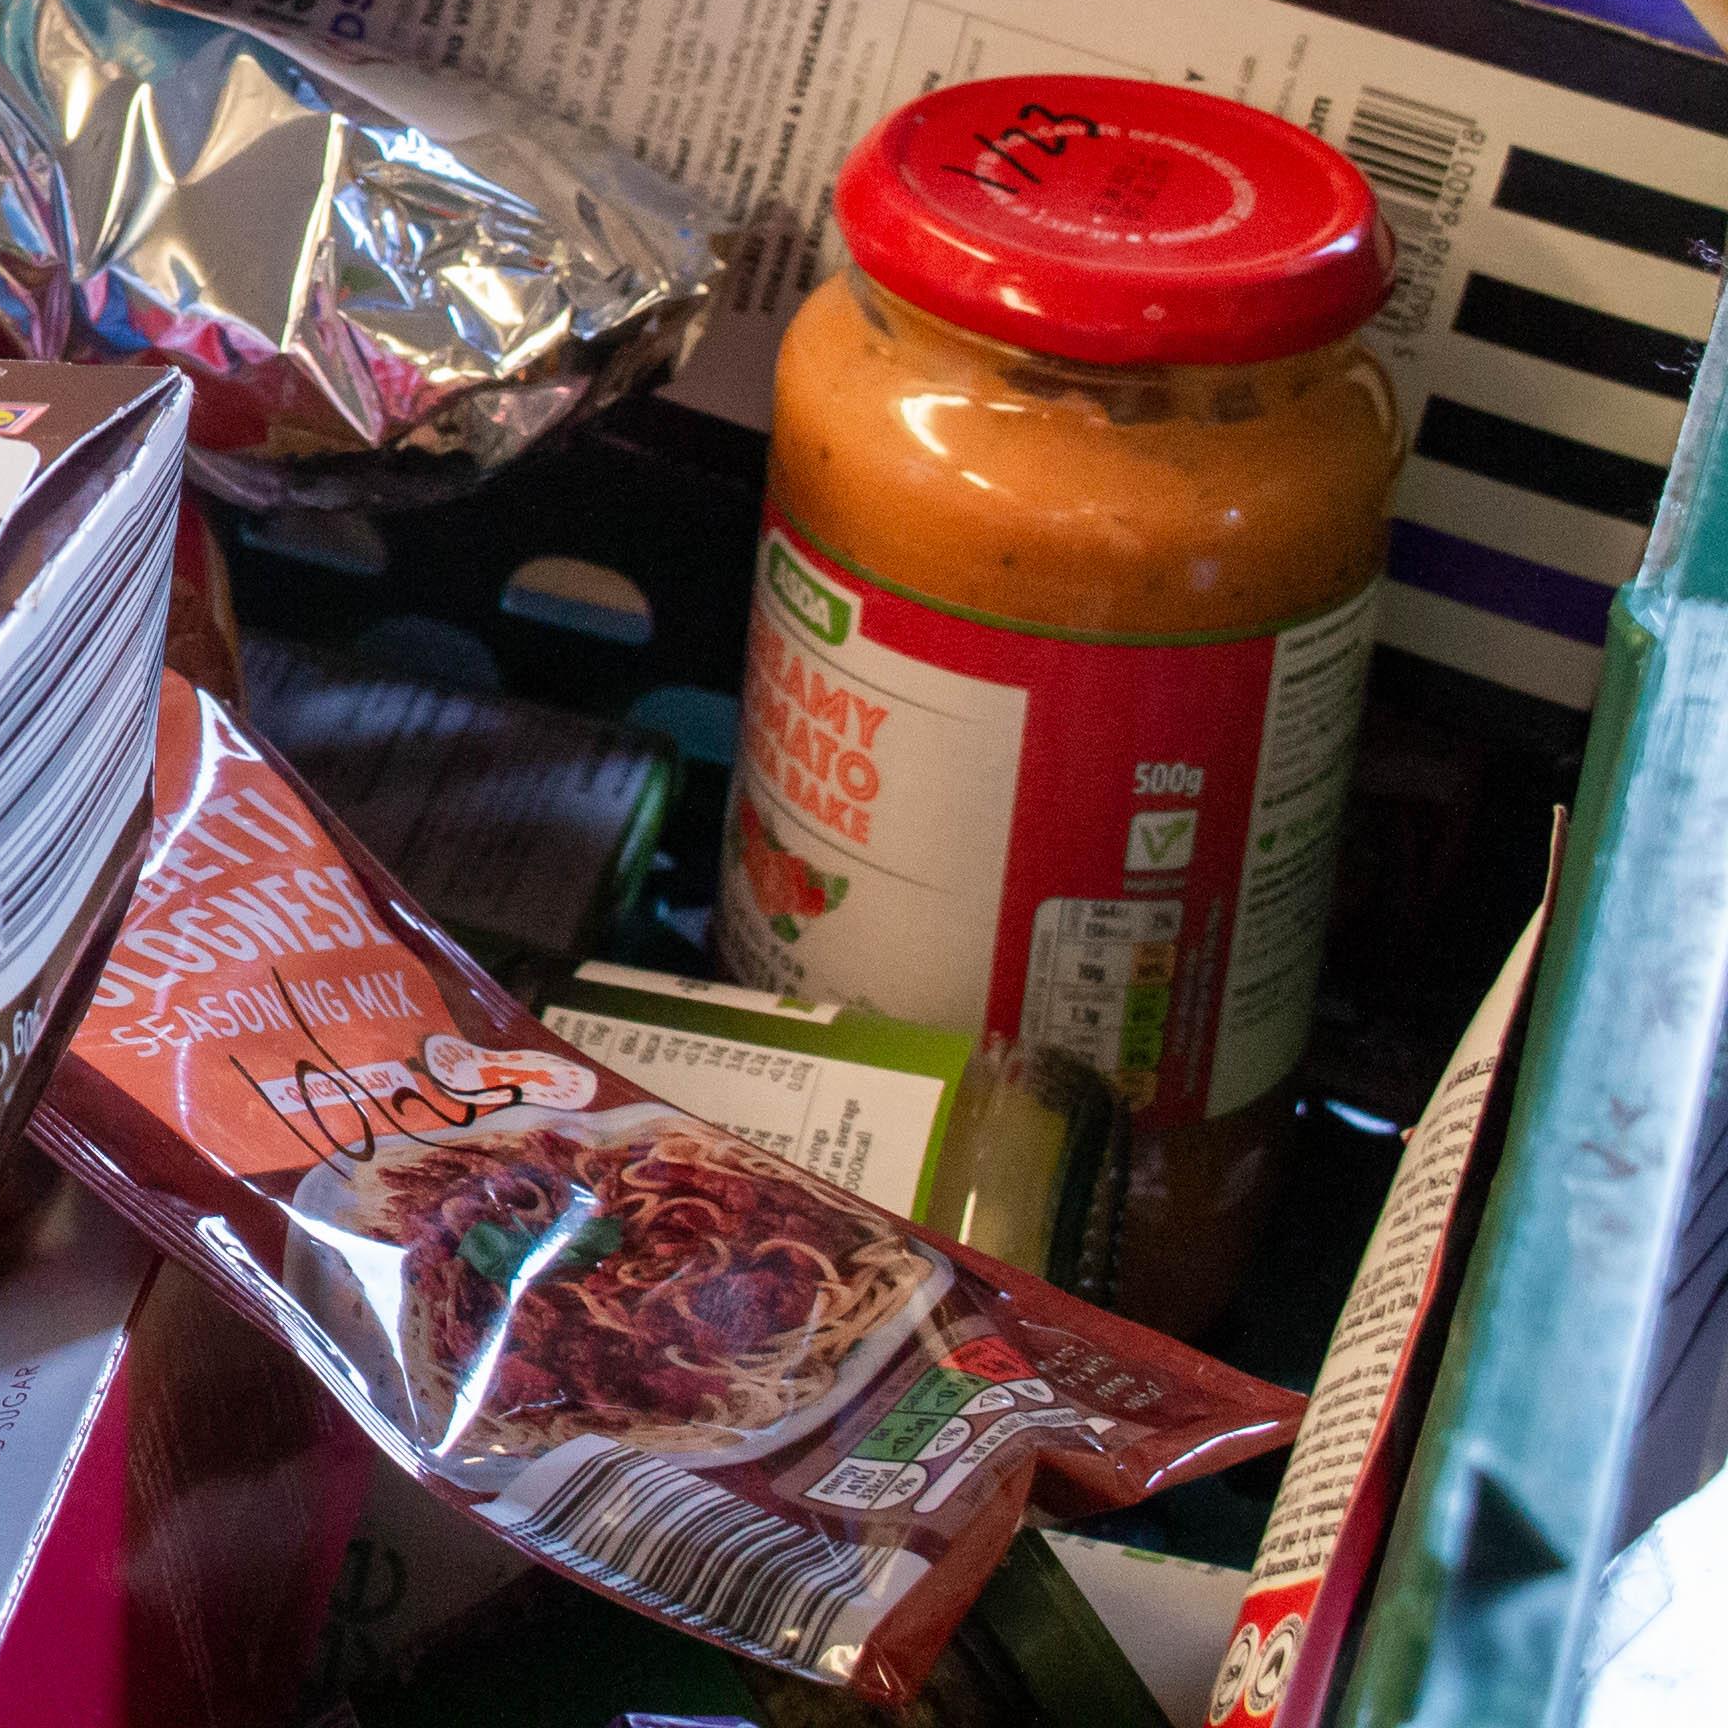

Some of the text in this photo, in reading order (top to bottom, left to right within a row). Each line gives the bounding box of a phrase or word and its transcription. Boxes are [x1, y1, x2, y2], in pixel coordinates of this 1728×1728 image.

[1133, 761, 1204, 797] 500g
[349, 971, 423, 1023] MIX
[831, 1095, 859, 1149] average
